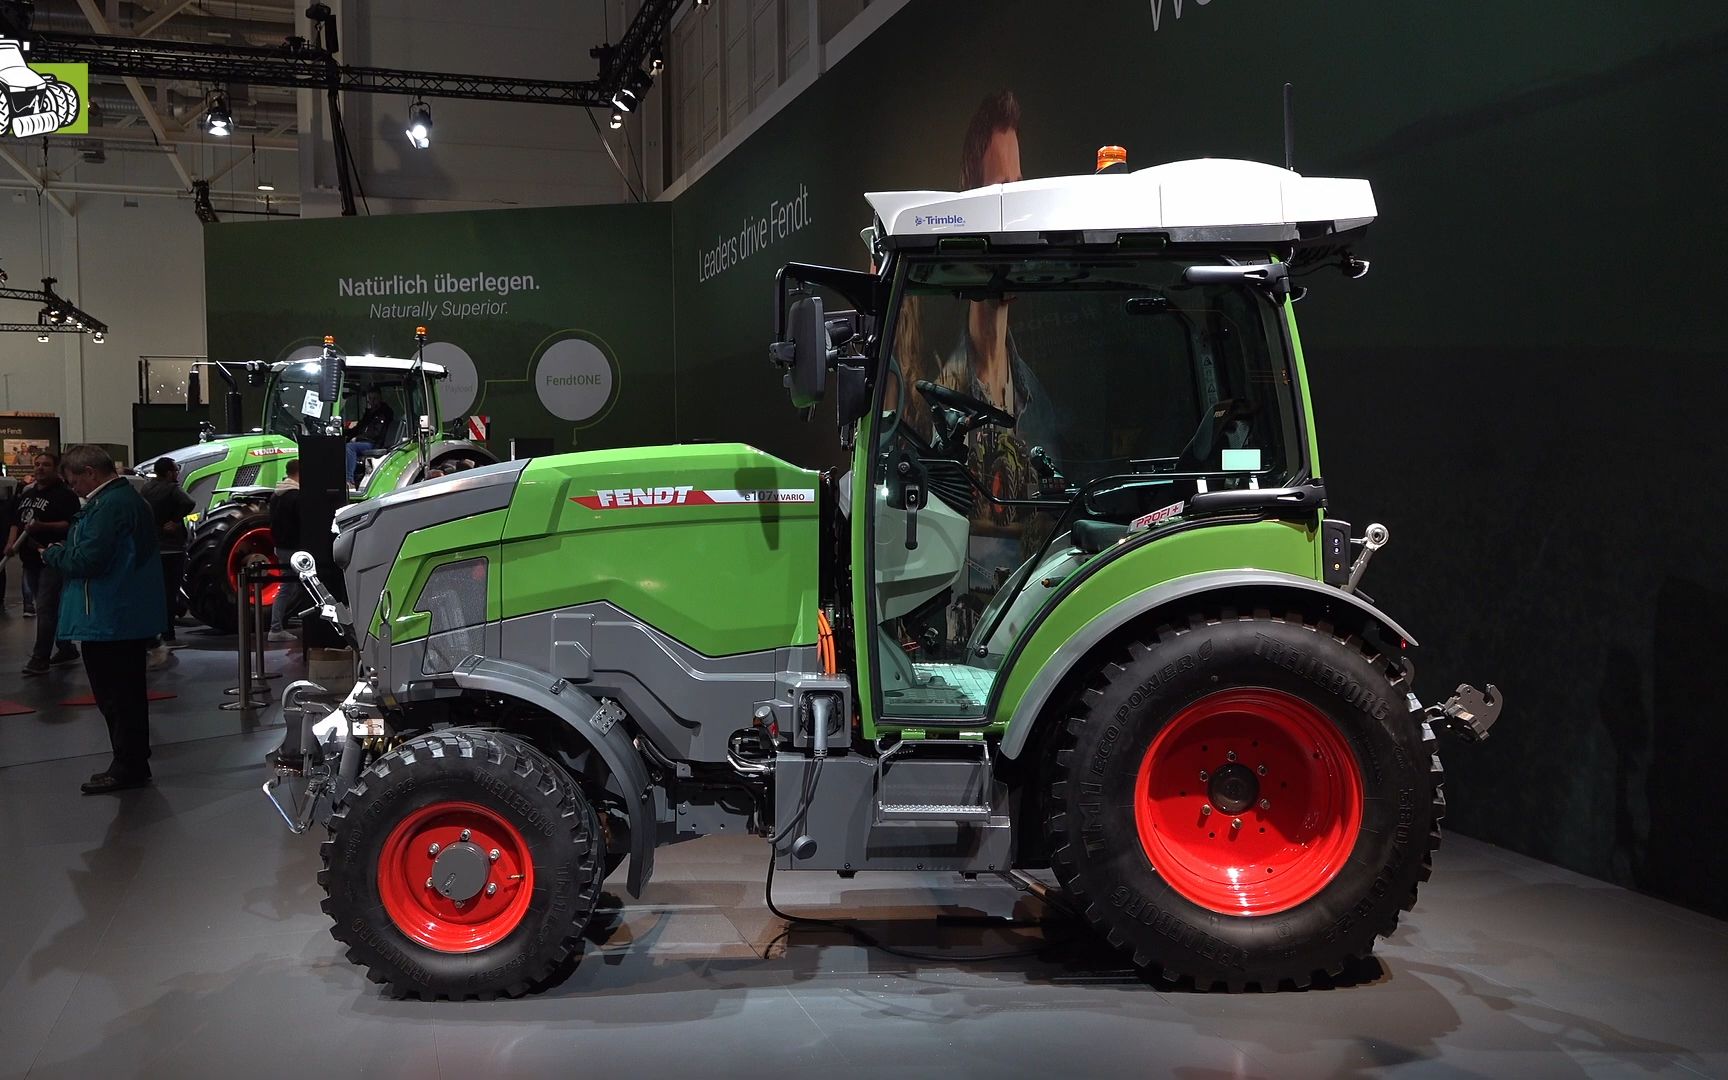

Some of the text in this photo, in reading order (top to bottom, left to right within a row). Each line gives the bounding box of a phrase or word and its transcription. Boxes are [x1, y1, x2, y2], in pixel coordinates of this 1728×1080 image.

[699, 183, 812, 283] Leaders drive Fendt.
[338, 271, 541, 297] Natürlich überlegen.
[369, 298, 509, 321] Naturally Superior.
[546, 374, 601, 386] FendtONE
[597, 485, 694, 507] FENDT
[781, 493, 805, 501] VARIO
[1253, 630, 1392, 723] TRELLEBORG
[473, 767, 558, 839] TRELLEBORG
